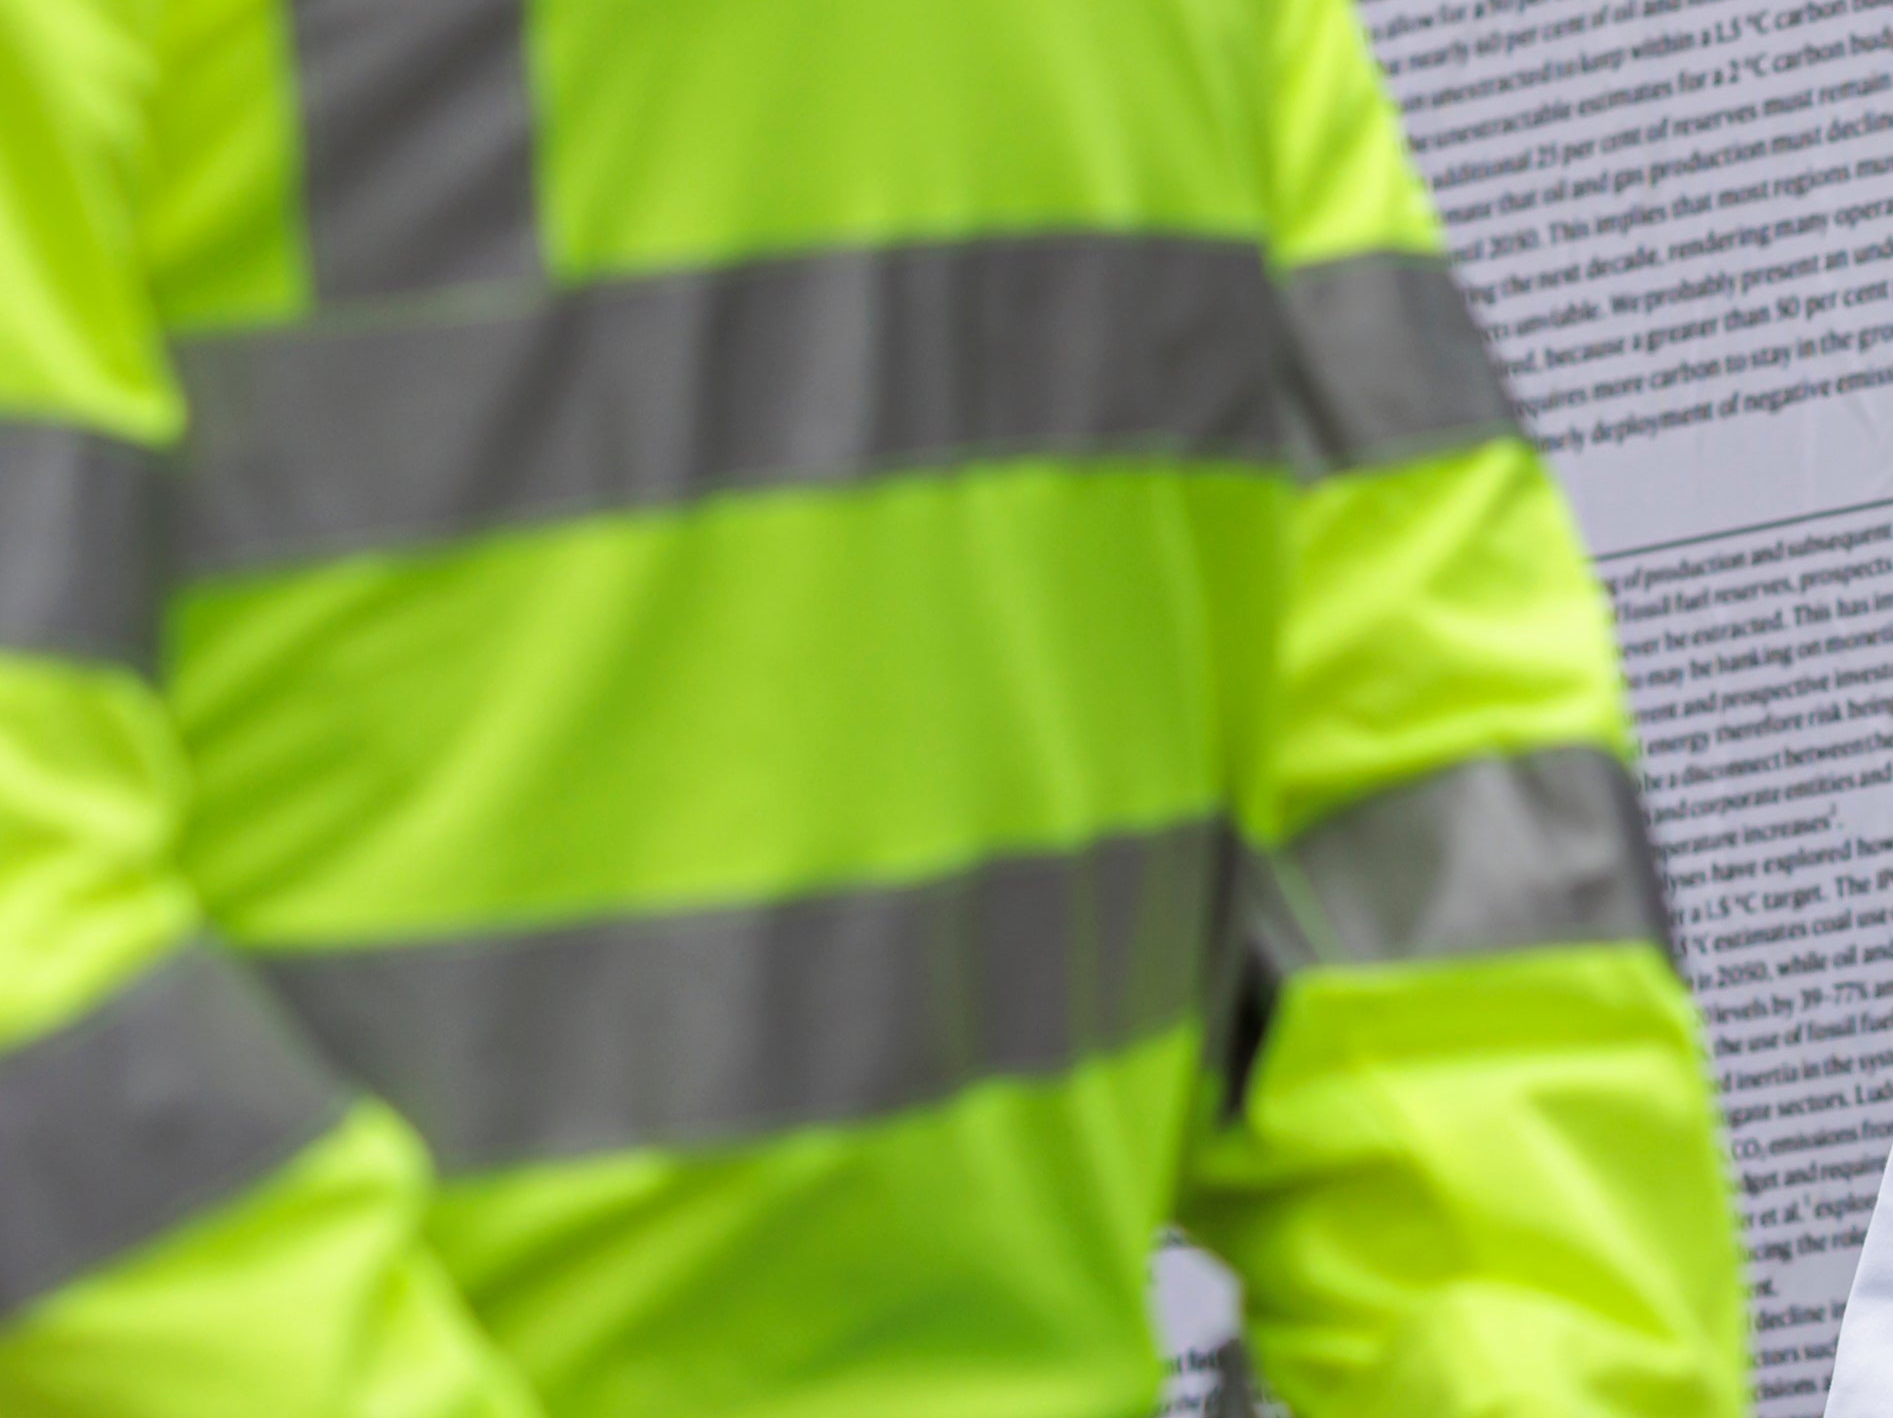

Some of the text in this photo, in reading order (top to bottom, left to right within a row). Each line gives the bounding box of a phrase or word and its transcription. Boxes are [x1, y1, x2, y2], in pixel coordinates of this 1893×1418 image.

[1769, 126, 1822, 155] must
[1742, 379, 1831, 414] negative
[1761, 839, 1852, 875] explored
[1834, 874, 1871, 897] The
